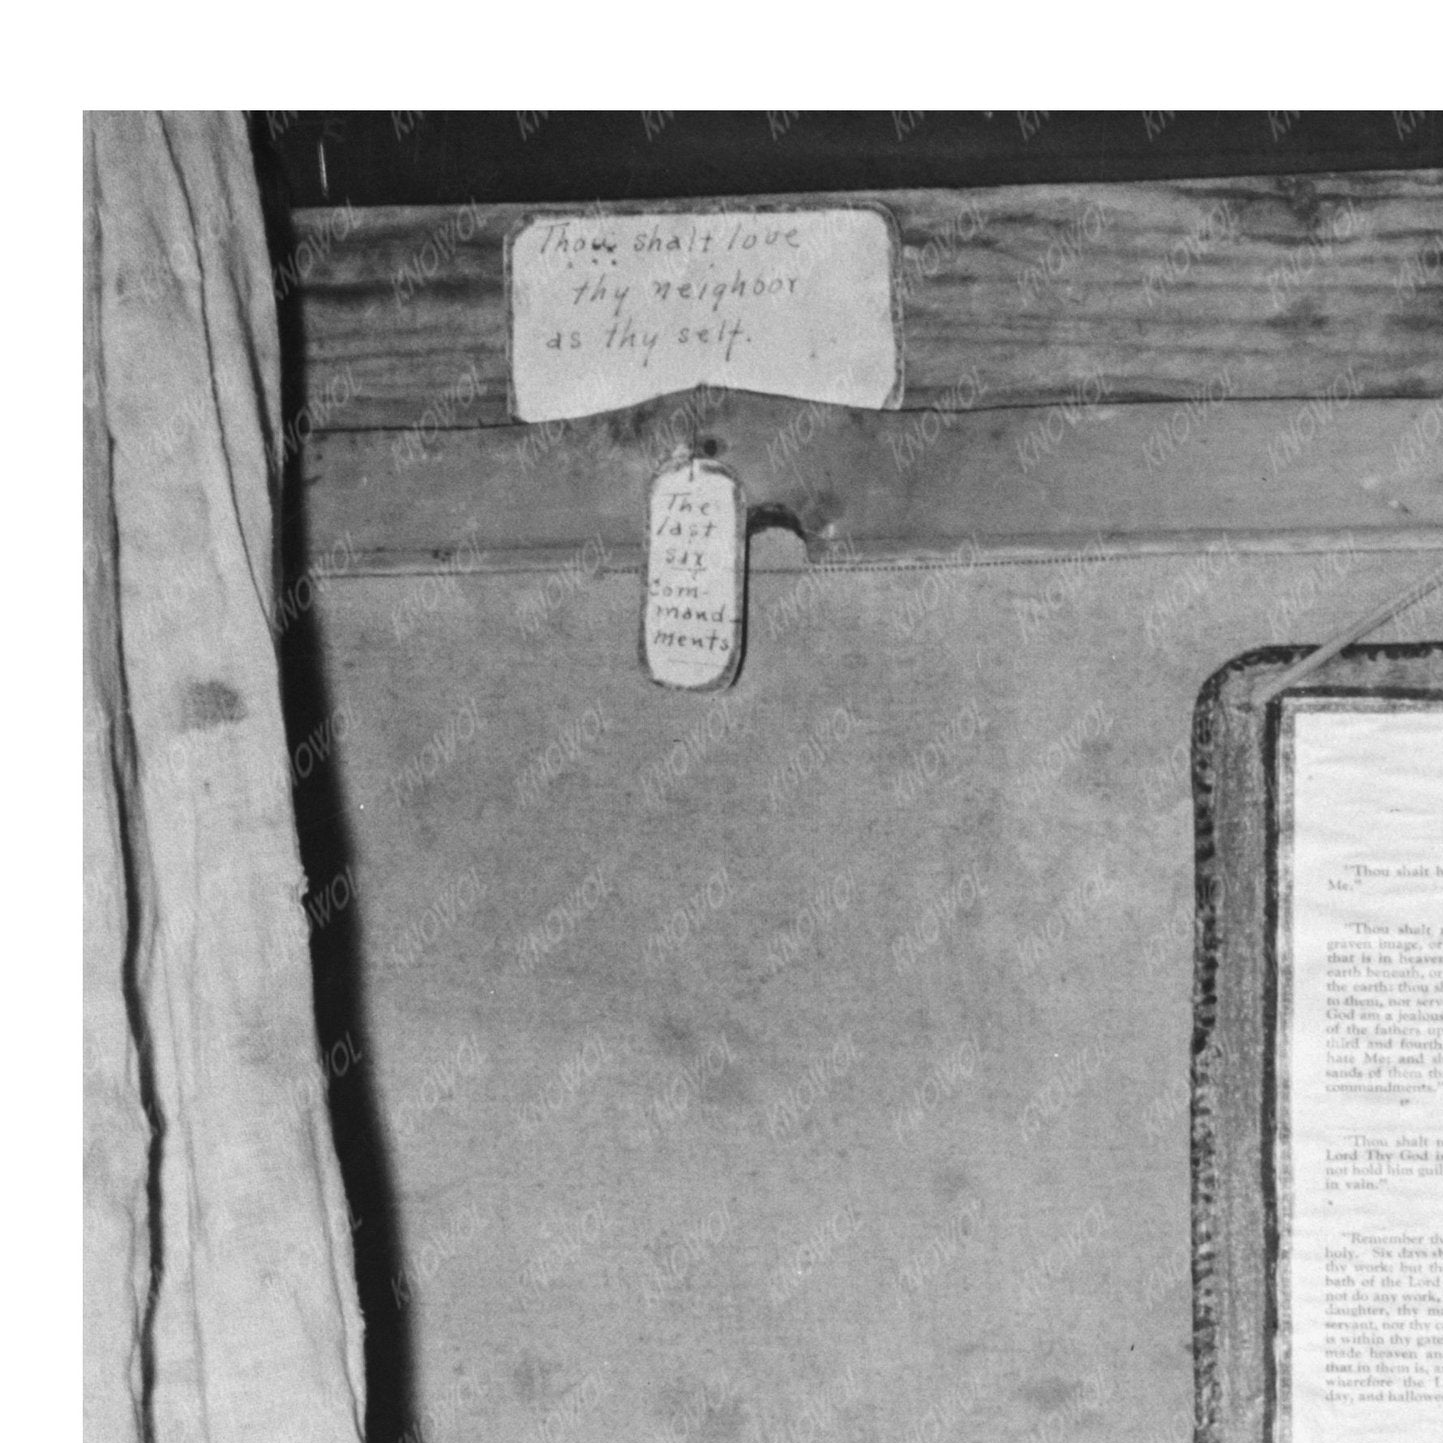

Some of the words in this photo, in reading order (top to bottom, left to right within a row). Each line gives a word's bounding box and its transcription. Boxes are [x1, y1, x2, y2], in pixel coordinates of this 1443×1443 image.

[541, 221, 617, 254] Thou
[633, 223, 713, 253] shalt
[728, 222, 800, 250] love
[572, 273, 630, 317] thy
[546, 331, 581, 350] as
[606, 317, 657, 367] thy
[663, 491, 710, 516] The
[653, 629, 729, 651] ments
